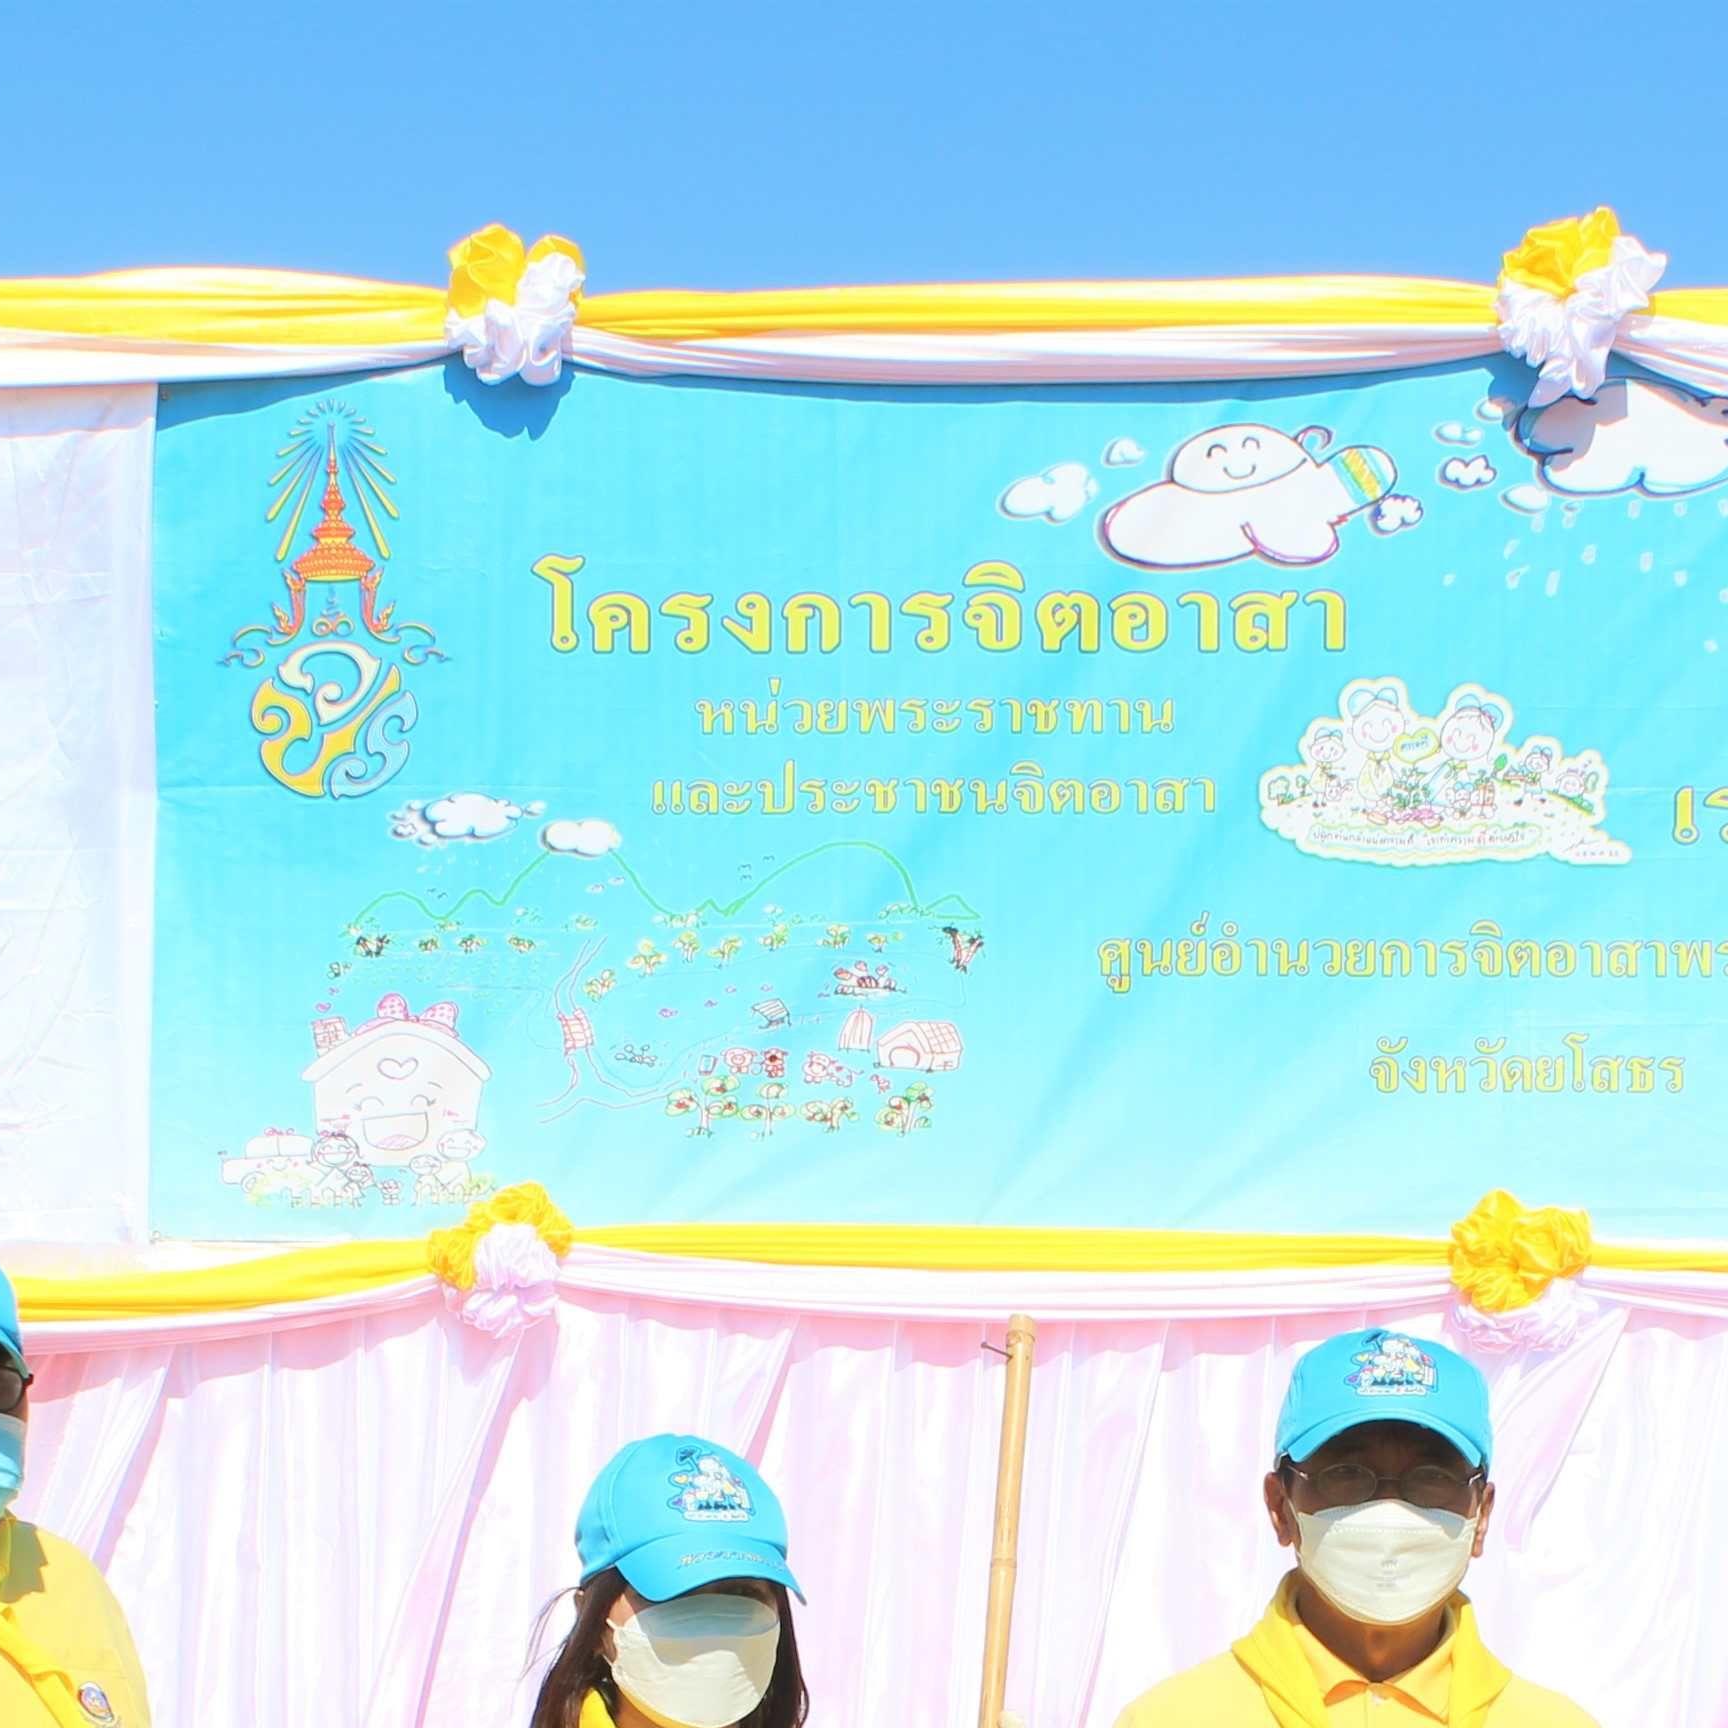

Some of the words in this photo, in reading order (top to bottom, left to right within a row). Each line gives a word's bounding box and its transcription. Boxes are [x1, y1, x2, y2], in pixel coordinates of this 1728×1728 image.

[530, 553, 1346, 654] โครงการจิตอาสา
[695, 678, 1174, 734] หน่วยพระราชทาน
[652, 759, 1216, 814] และประชาชนจิตอาสา
[1369, 1033, 1686, 1093] จังหวัดยโสธร
